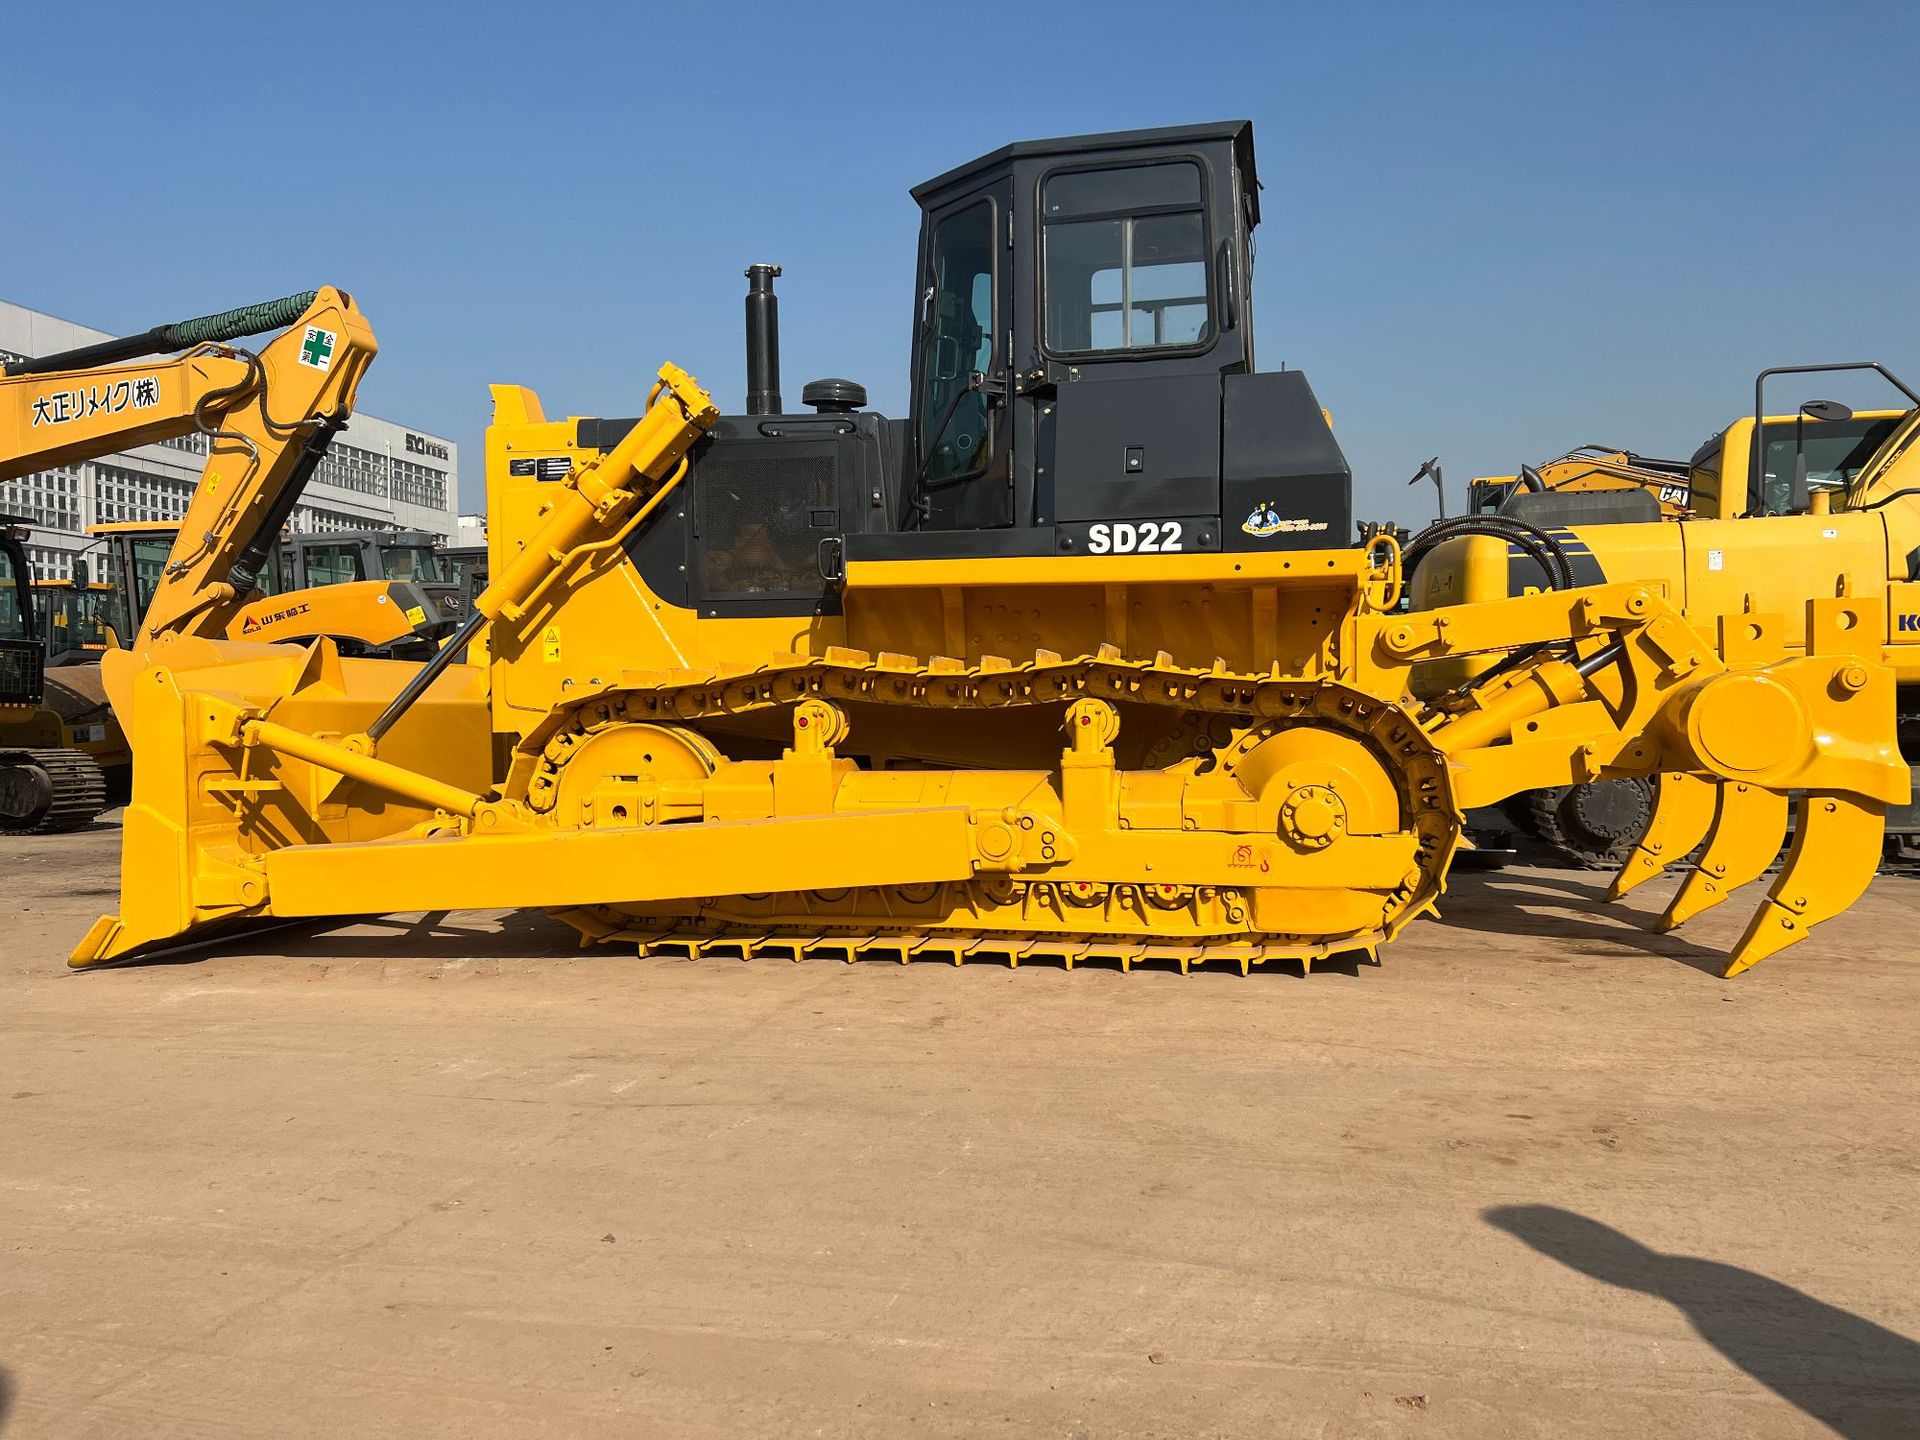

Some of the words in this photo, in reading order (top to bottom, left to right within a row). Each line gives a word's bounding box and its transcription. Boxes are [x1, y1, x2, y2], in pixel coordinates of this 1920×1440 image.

[32, 376, 160, 426] 大正リメイク(株)
[1088, 521, 1183, 554] SD22
[261, 603, 311, 626] 山东临工
[1898, 614, 1920, 632] K
